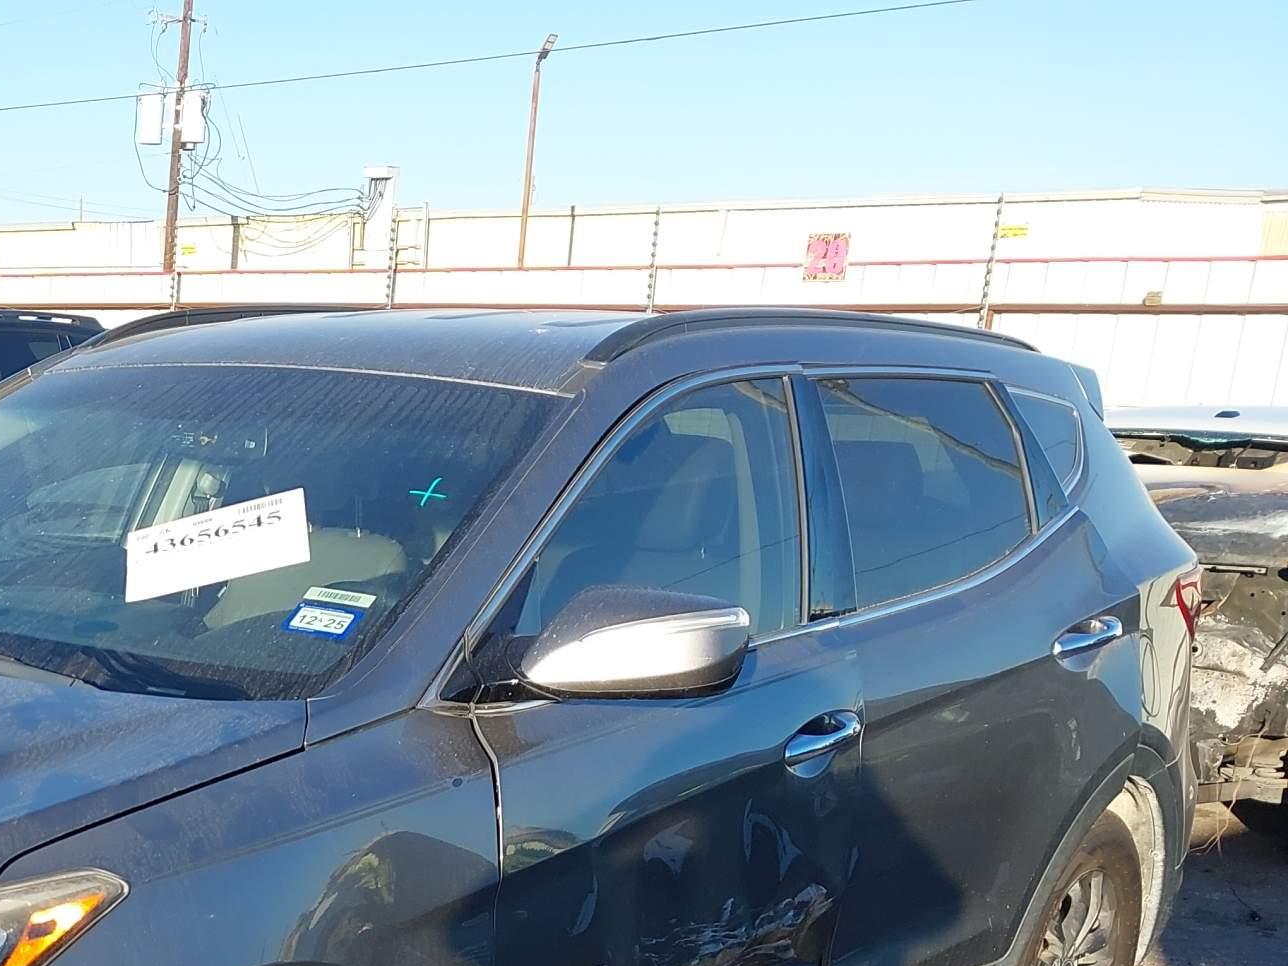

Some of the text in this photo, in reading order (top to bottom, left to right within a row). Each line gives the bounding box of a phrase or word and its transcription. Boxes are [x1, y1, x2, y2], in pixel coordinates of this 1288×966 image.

[145, 511, 282, 554] 43656545
[299, 615, 318, 626] 12
[323, 618, 347, 630] 25
